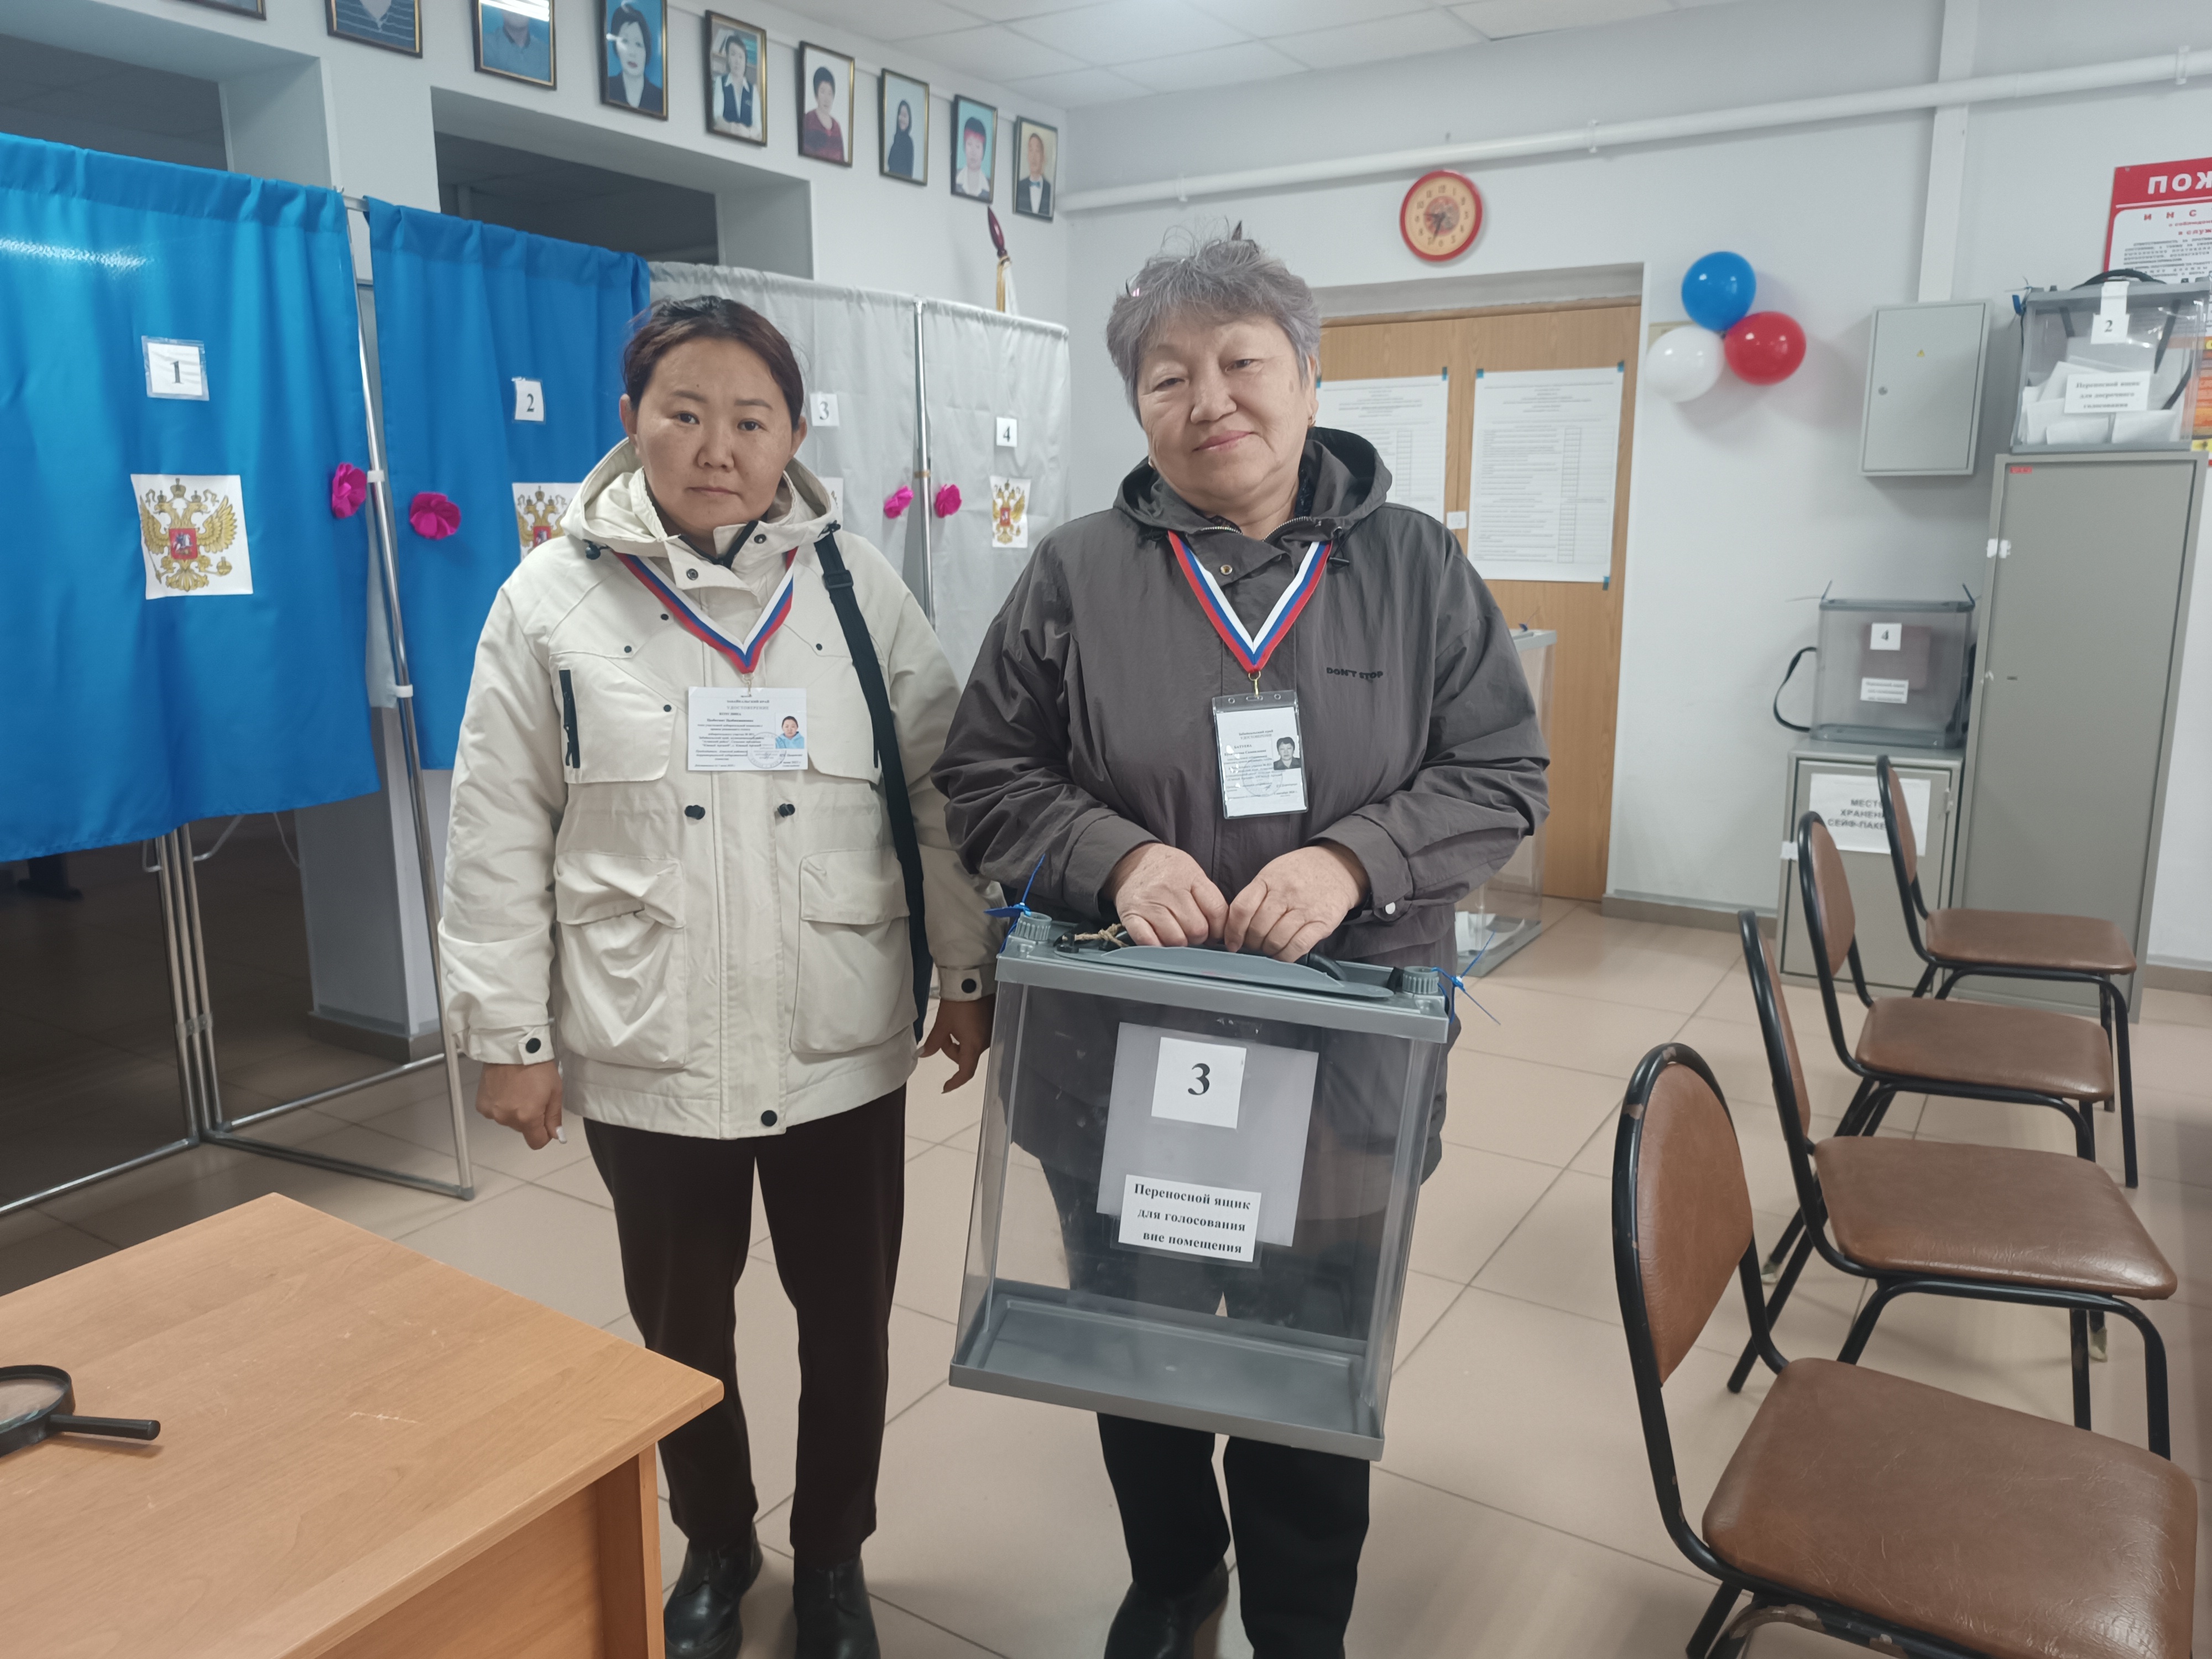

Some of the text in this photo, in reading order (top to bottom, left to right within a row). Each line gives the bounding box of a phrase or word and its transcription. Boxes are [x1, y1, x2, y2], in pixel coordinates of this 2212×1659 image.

[2104, 320, 2113, 332] 2
[169, 360, 184, 384] 1
[526, 393, 535, 413] 2
[819, 401, 830, 420] 3
[1003, 425, 1011, 442] 4
[1880, 629, 1889, 641] 4
[1359, 670, 1384, 680] STOP
[1840, 809, 1884, 818] ХРАНЕН
[1187, 1062, 1211, 1095] 3
[1134, 1183, 1251, 1210] Переносной ящик
[1137, 1208, 1246, 1232] для голосования
[1142, 1232, 1242, 1254] вне помещения
